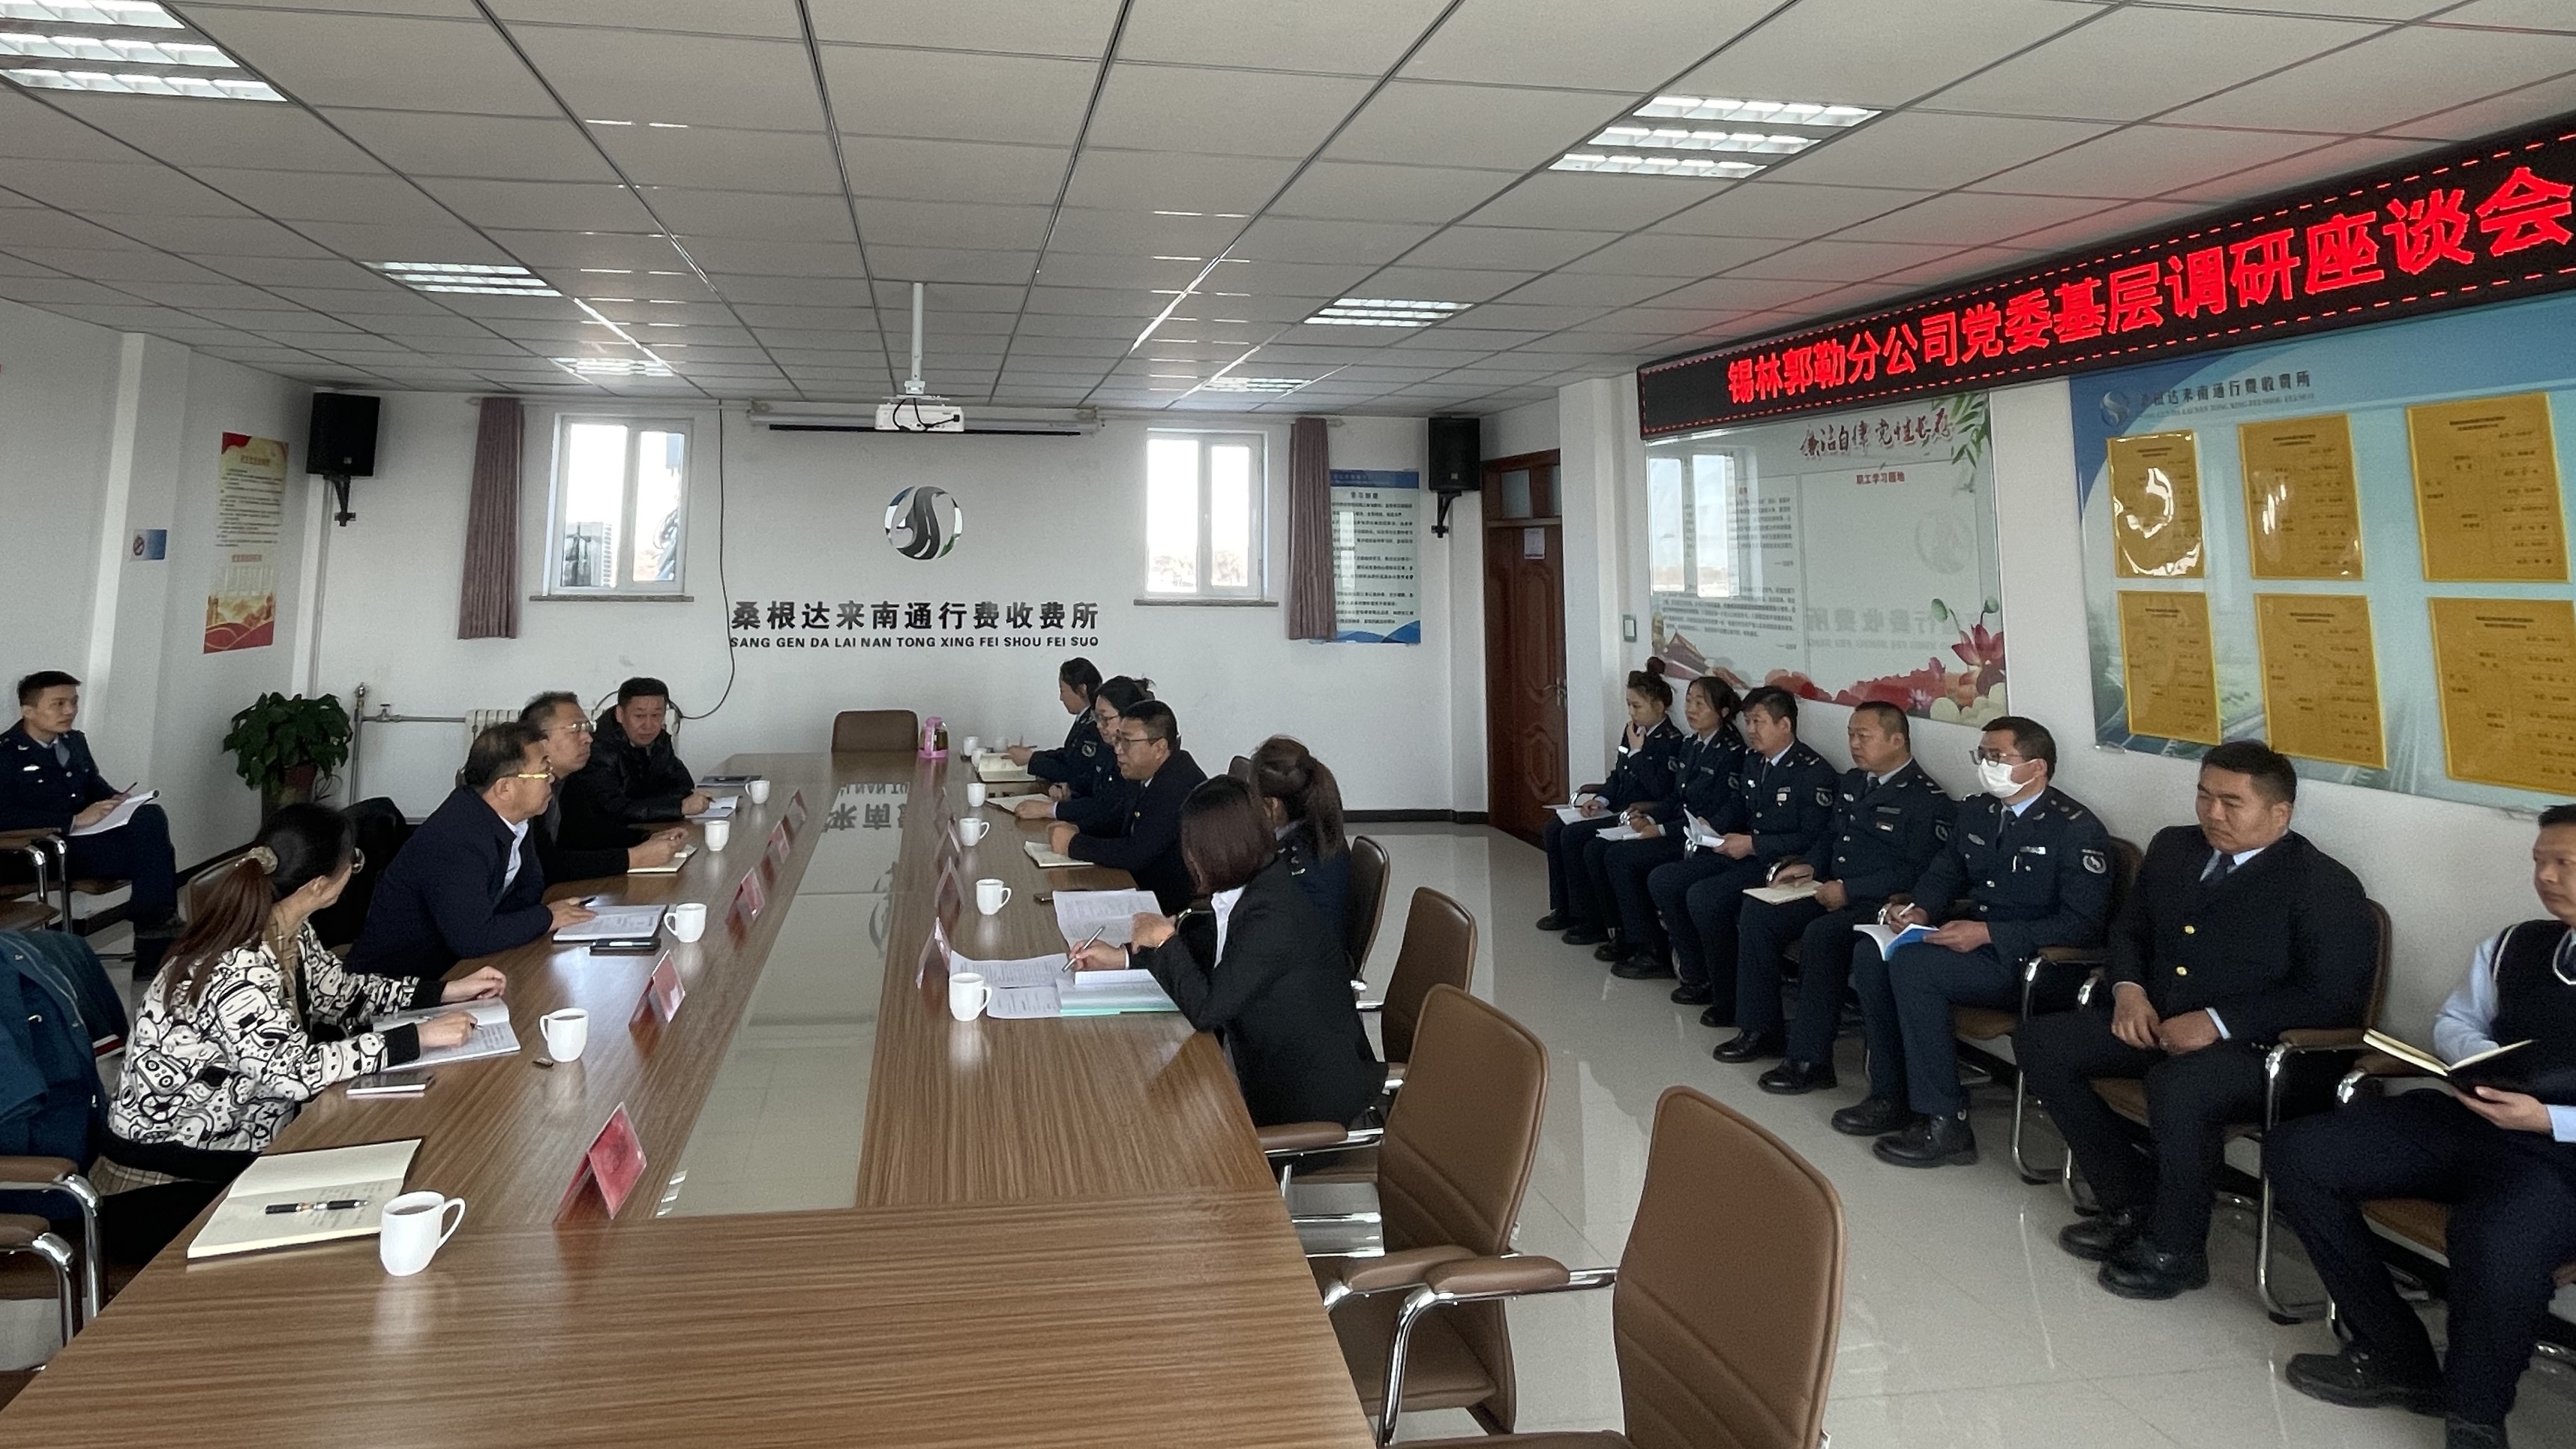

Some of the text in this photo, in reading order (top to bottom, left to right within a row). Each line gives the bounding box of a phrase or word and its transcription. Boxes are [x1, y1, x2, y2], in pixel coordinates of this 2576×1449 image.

[1727, 166, 2575, 405] 锡林郭勒分公司党委基层调研座谈会
[1856, 471, 1906, 484] 职工学习园地
[731, 600, 1099, 630] 桑根达来南通行费收费所
[730, 637, 1099, 648] SANG GEN DA LAI NAN TONG XING FEI SHOU FEI SUO
